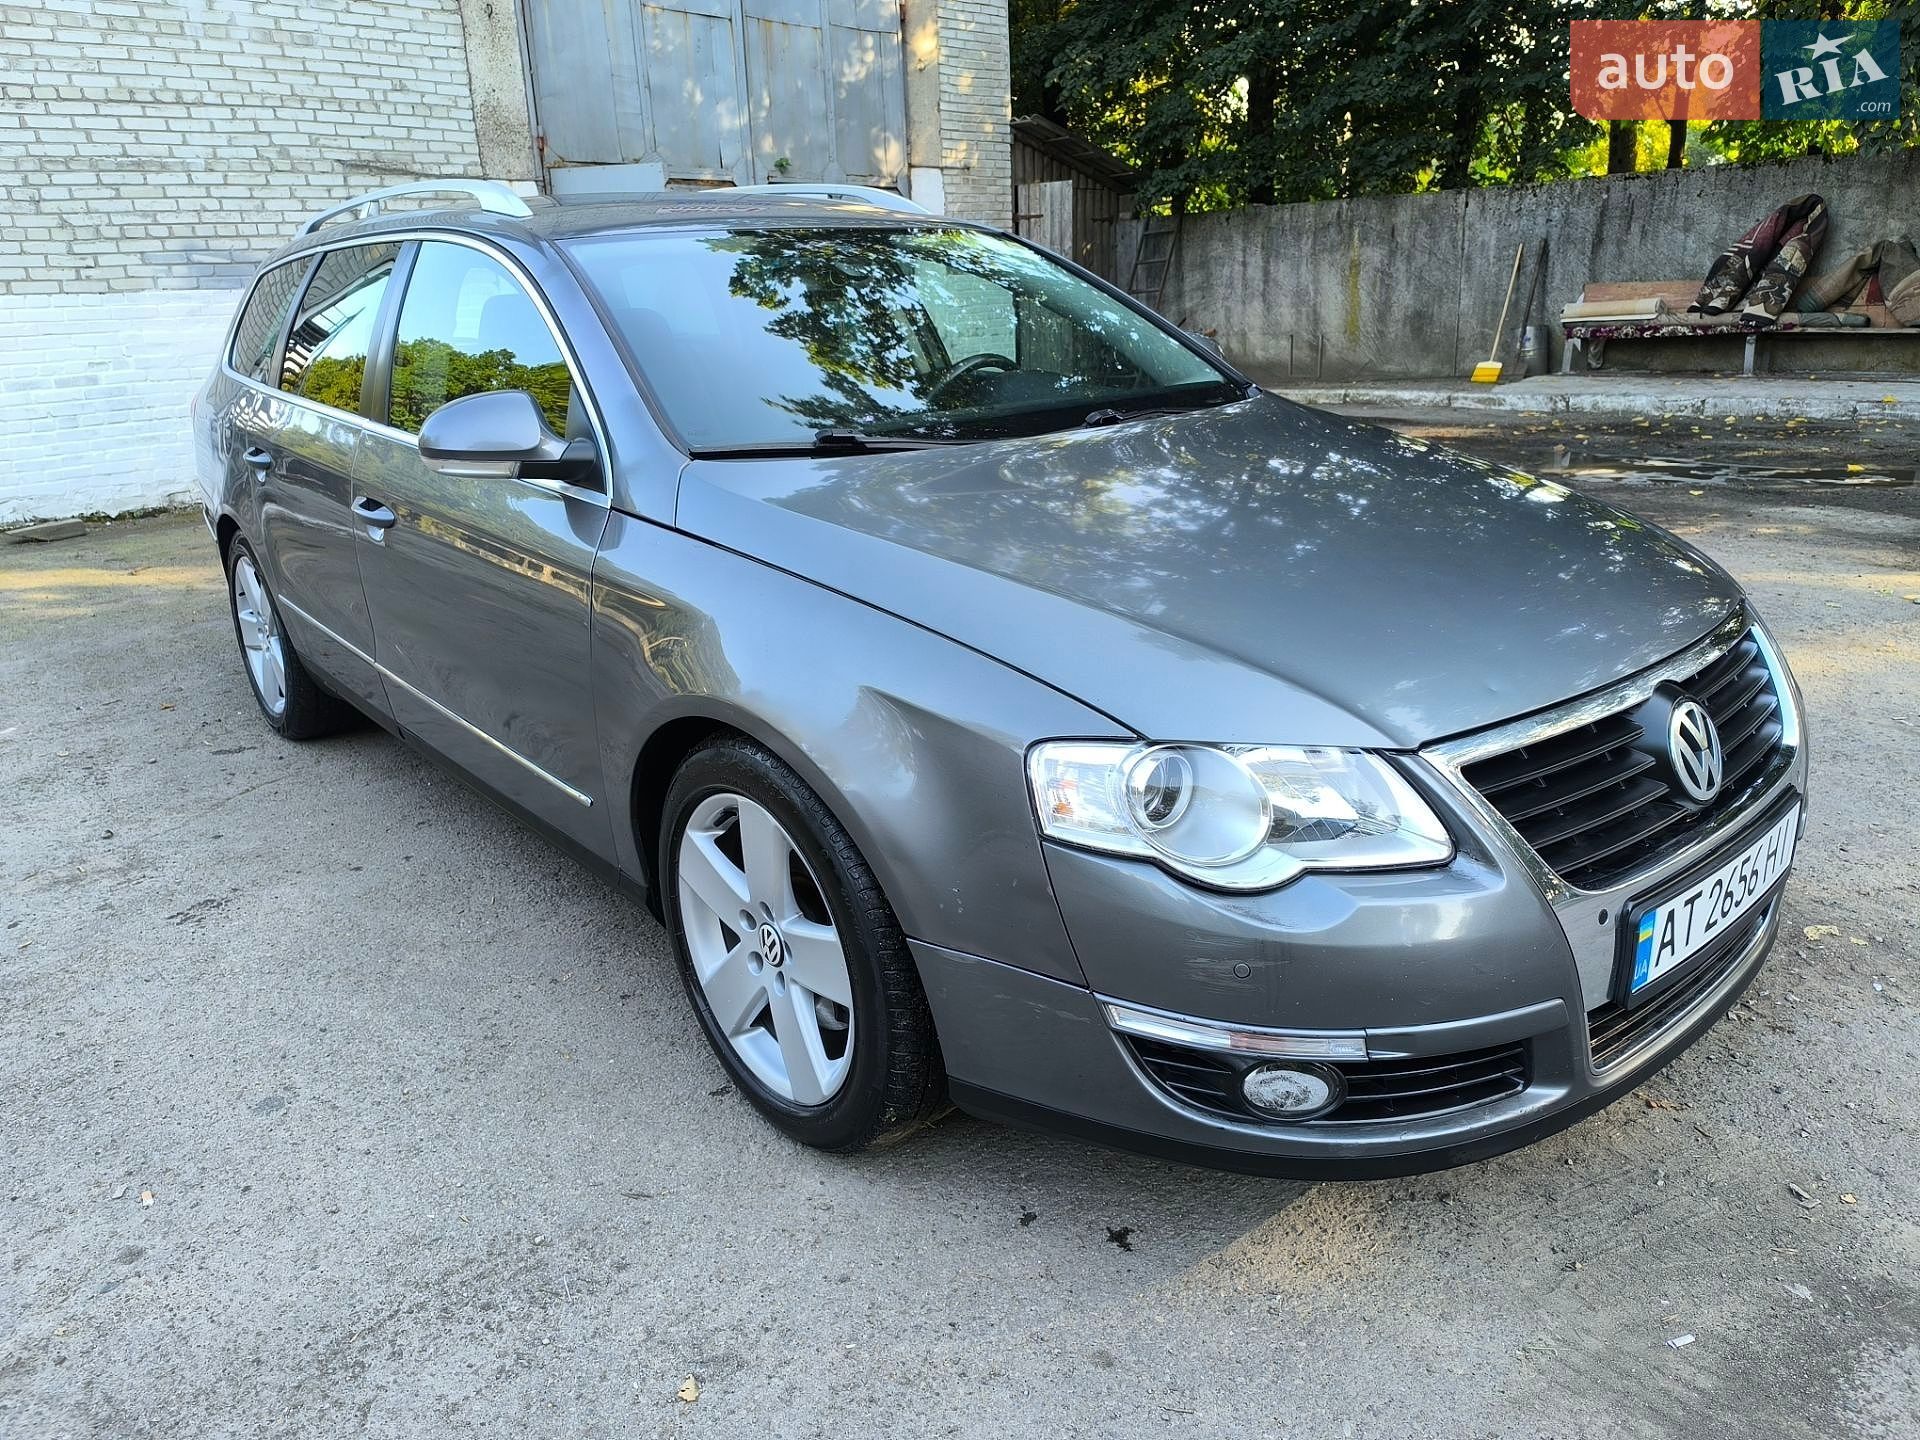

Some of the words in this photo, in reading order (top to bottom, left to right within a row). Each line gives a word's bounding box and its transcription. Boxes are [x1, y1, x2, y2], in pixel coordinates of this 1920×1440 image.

[1655, 889, 1703, 968] AT
[1704, 844, 1763, 934] 2656
[1763, 818, 1790, 884] HI
[1634, 959, 1648, 980] UA
